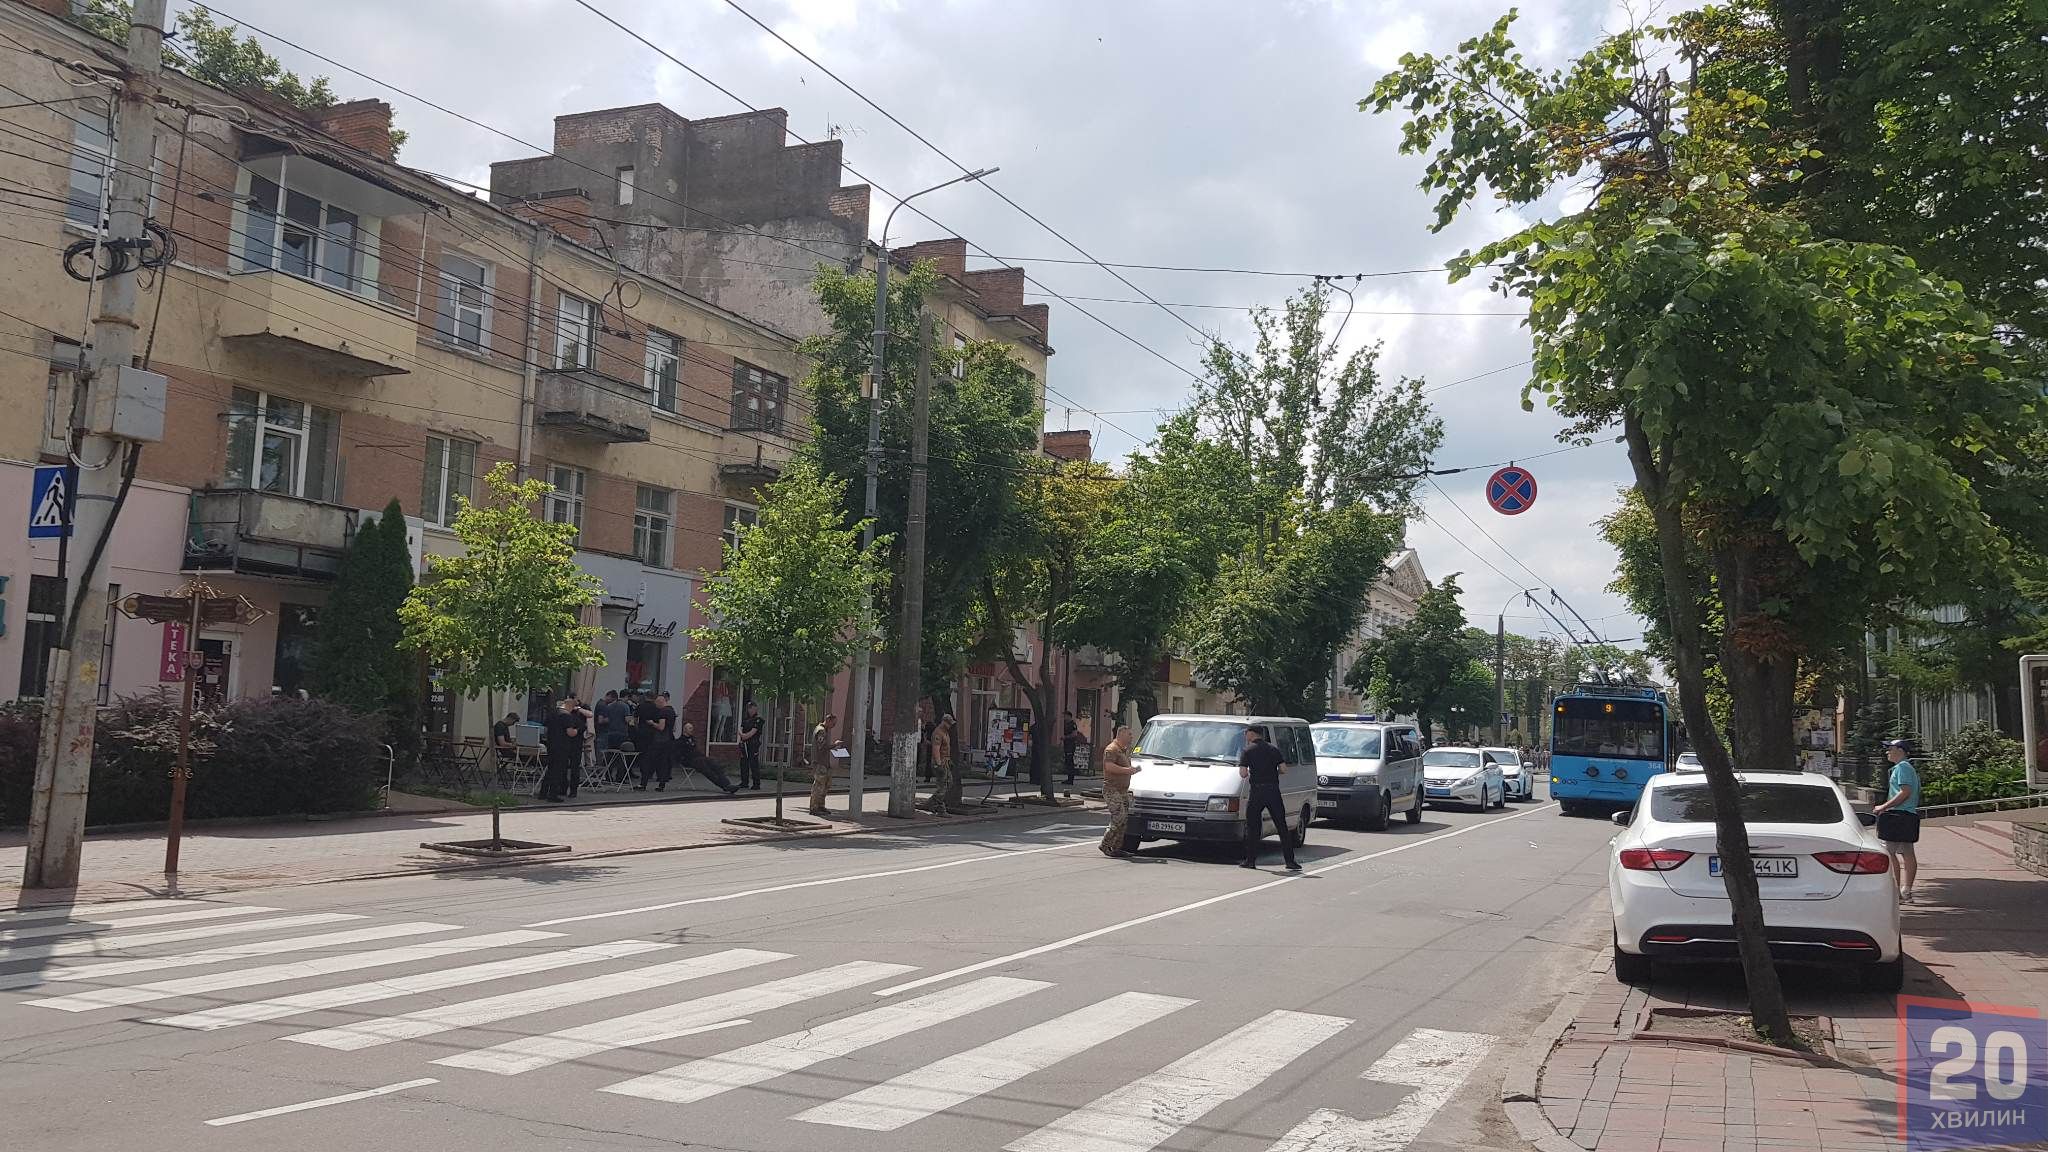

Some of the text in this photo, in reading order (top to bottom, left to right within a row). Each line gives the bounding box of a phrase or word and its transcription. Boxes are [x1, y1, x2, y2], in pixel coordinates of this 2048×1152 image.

[167, 621, 179, 673] ПТЕКА
[1605, 703, 1613, 713] 9
[1776, 860, 1792, 873] IK
